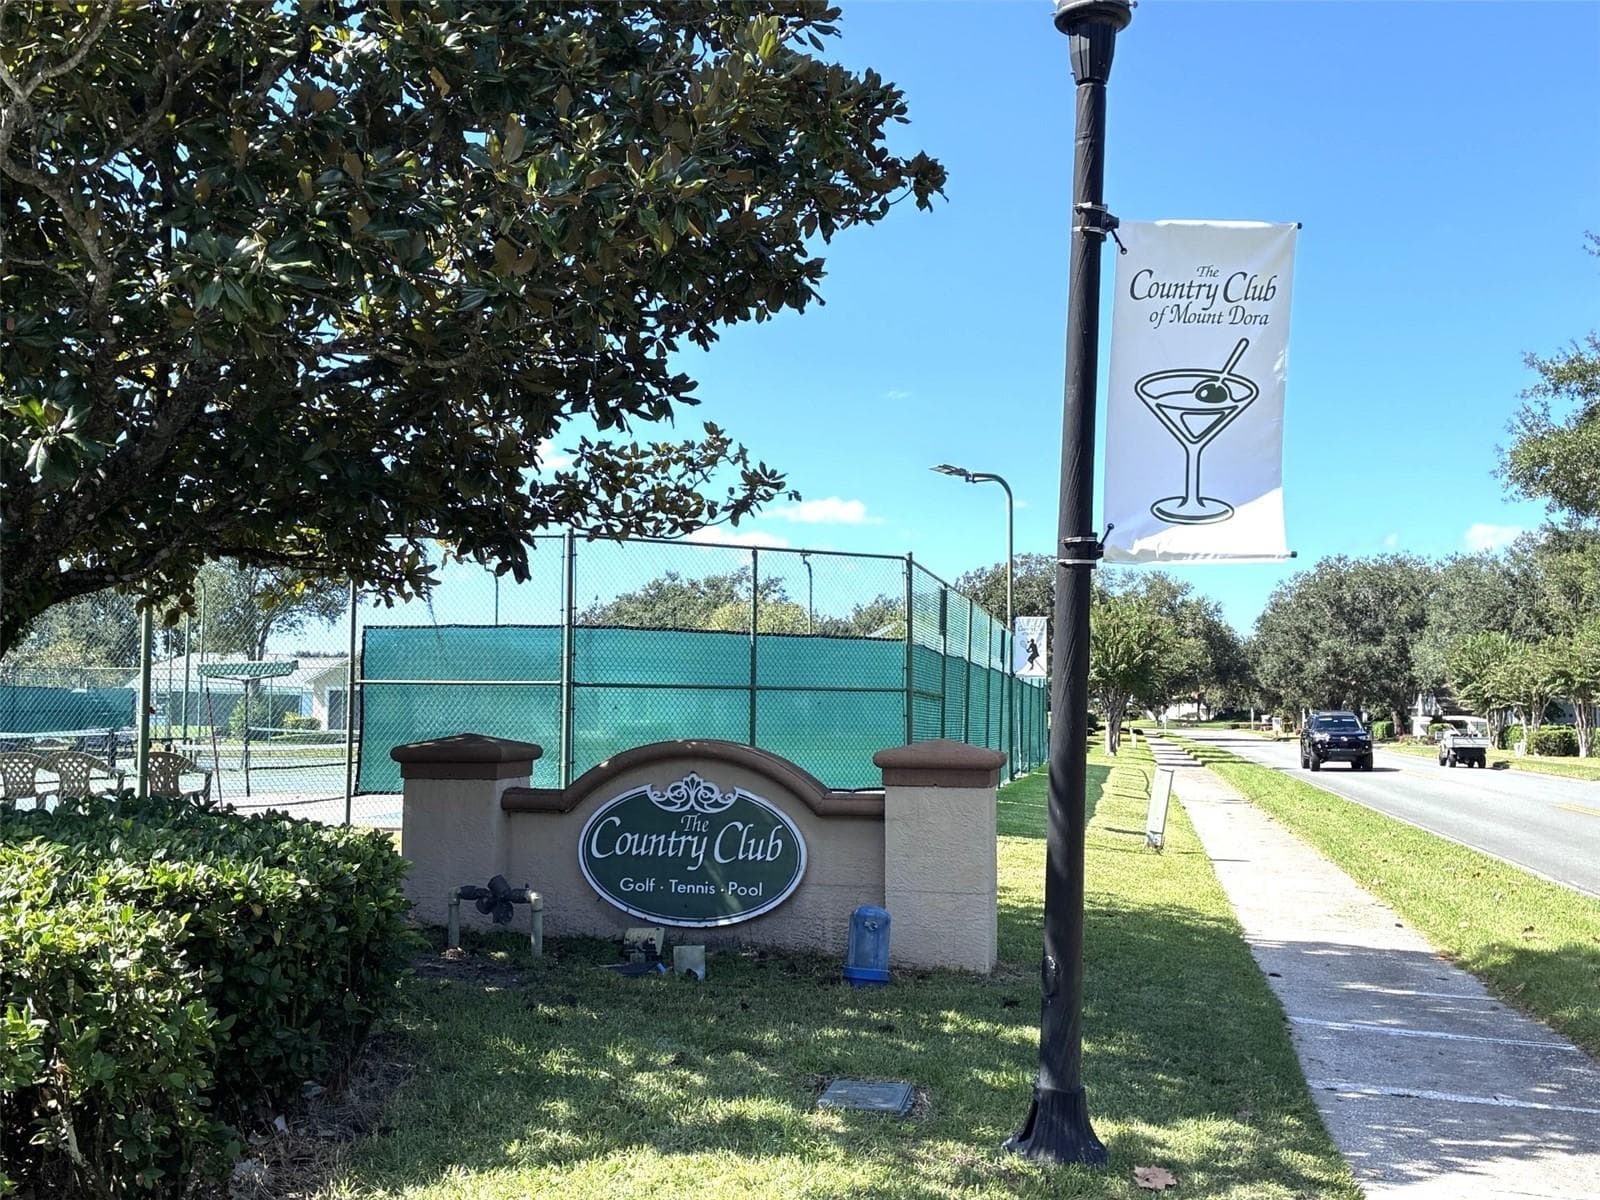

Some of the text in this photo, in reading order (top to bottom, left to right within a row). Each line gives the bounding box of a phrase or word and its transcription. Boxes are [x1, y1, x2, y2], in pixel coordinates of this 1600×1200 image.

[1196, 264, 1219, 278] The
[1129, 268, 1277, 310] Country Club
[1149, 301, 1270, 329] of Mount Dora
[680, 813, 709, 833] The
[590, 816, 783, 871] Country Club
[619, 877, 763, 897] Golf Tennis Pool
